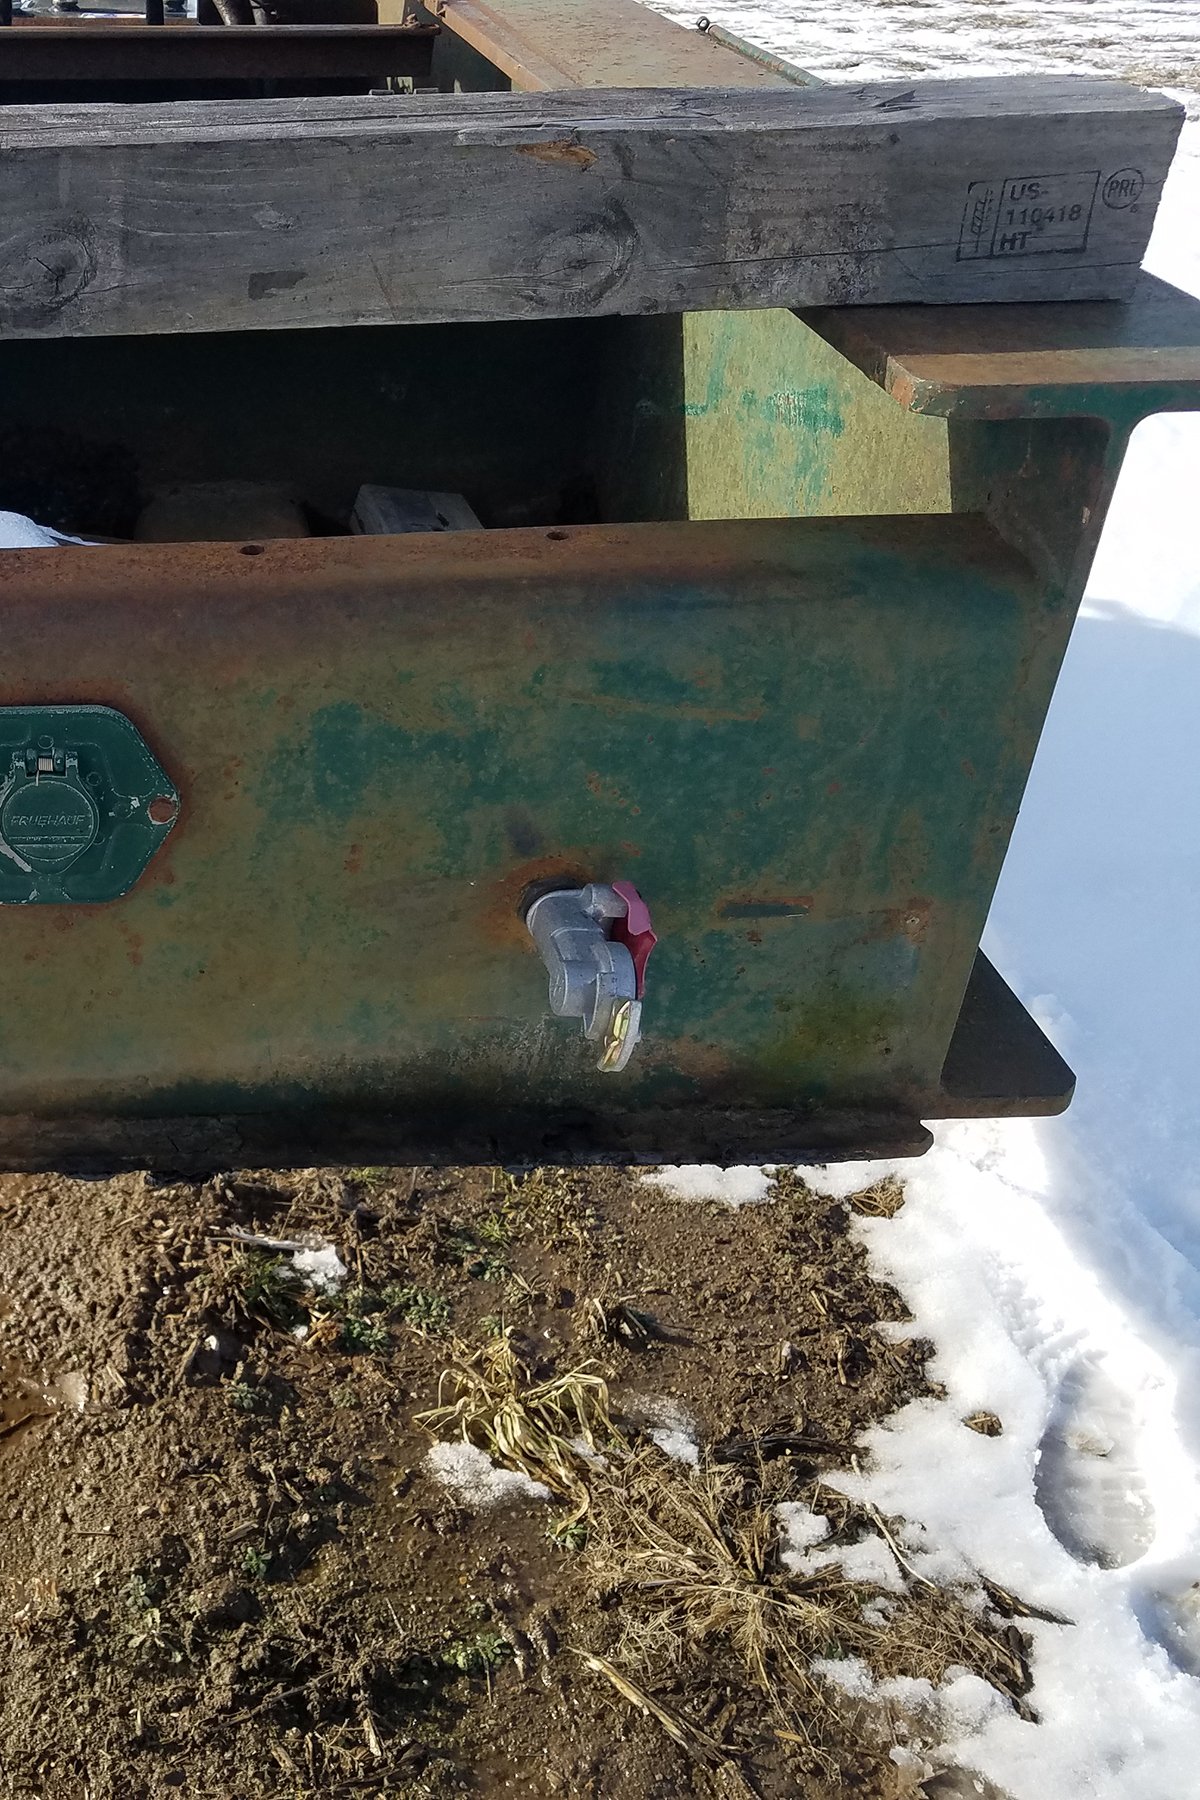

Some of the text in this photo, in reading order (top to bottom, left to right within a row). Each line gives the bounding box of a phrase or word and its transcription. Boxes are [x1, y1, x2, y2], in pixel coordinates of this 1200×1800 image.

[1006, 204, 1082, 225] 110418
[1000, 231, 1032, 251] HT
[11, 814, 86, 827] FRUEHAUF
